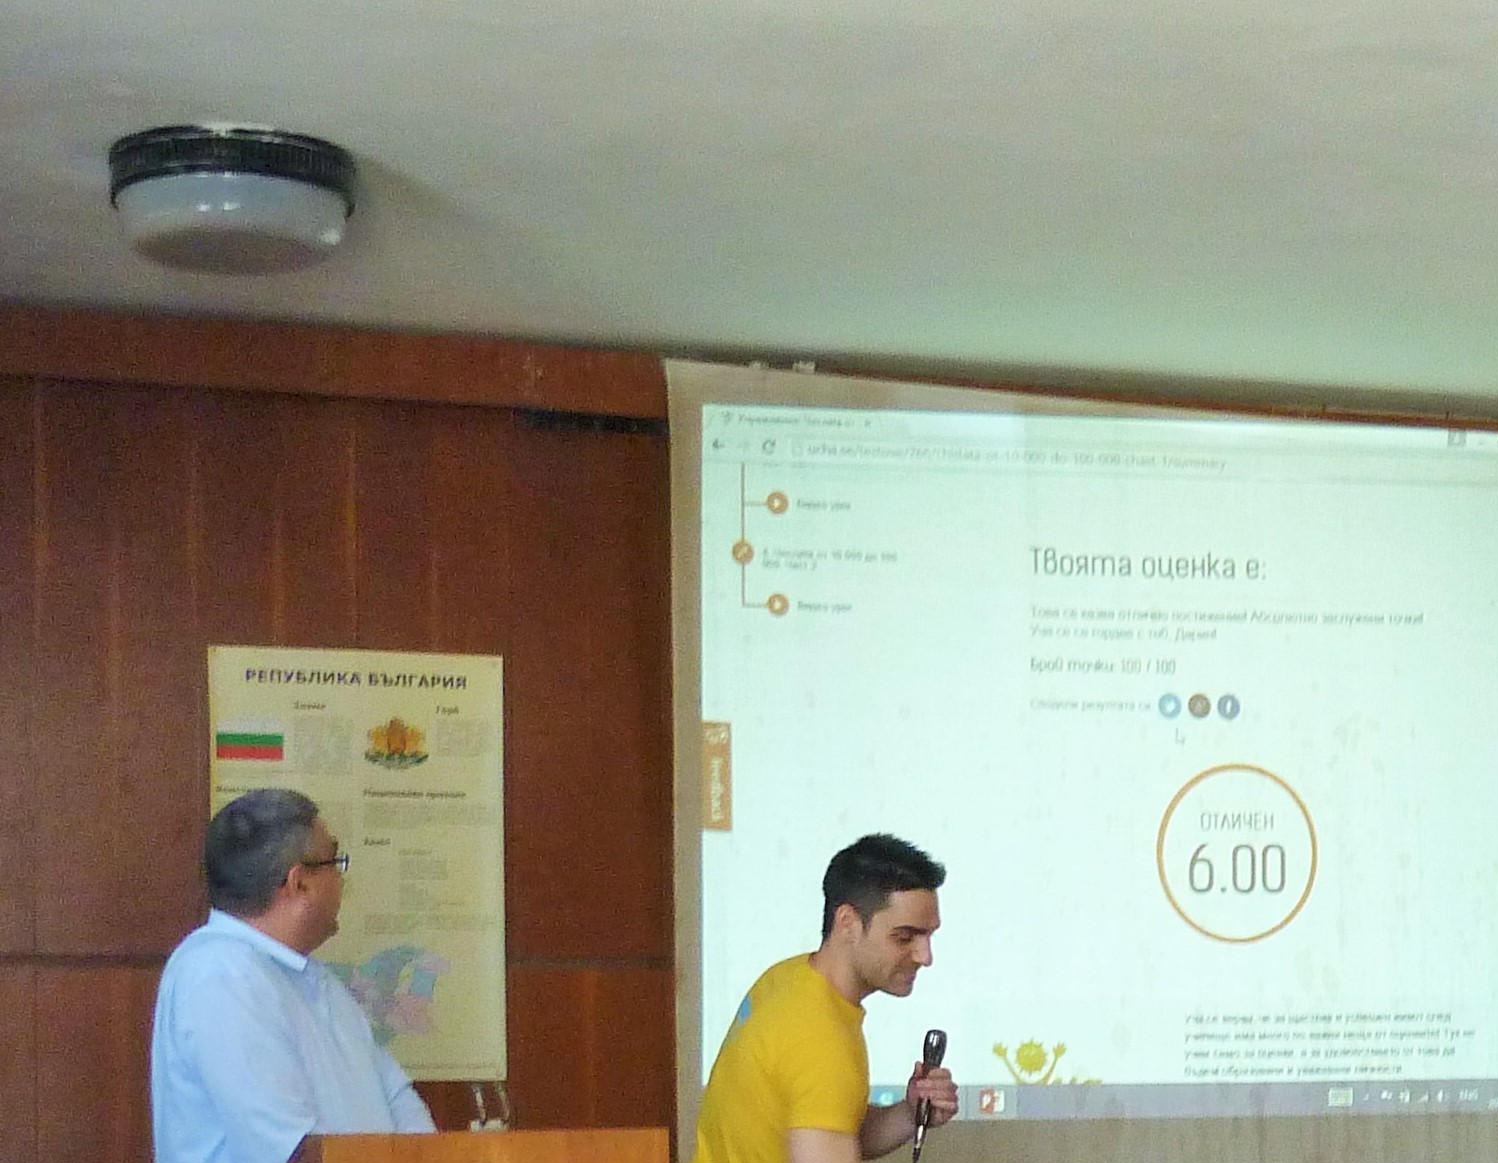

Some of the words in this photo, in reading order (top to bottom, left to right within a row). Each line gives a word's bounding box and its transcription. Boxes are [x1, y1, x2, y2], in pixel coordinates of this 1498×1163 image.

[1029, 546, 1132, 577] Твоята
[1141, 551, 1236, 581] оценка
[1245, 558, 1267, 581] е:
[245, 667, 361, 686] РЕПУБЛИКА
[368, 671, 467, 690] БЪЛГАРИЯ
[1200, 811, 1274, 832] ОТЛИЧЕН
[1187, 841, 1287, 894] 6.00
